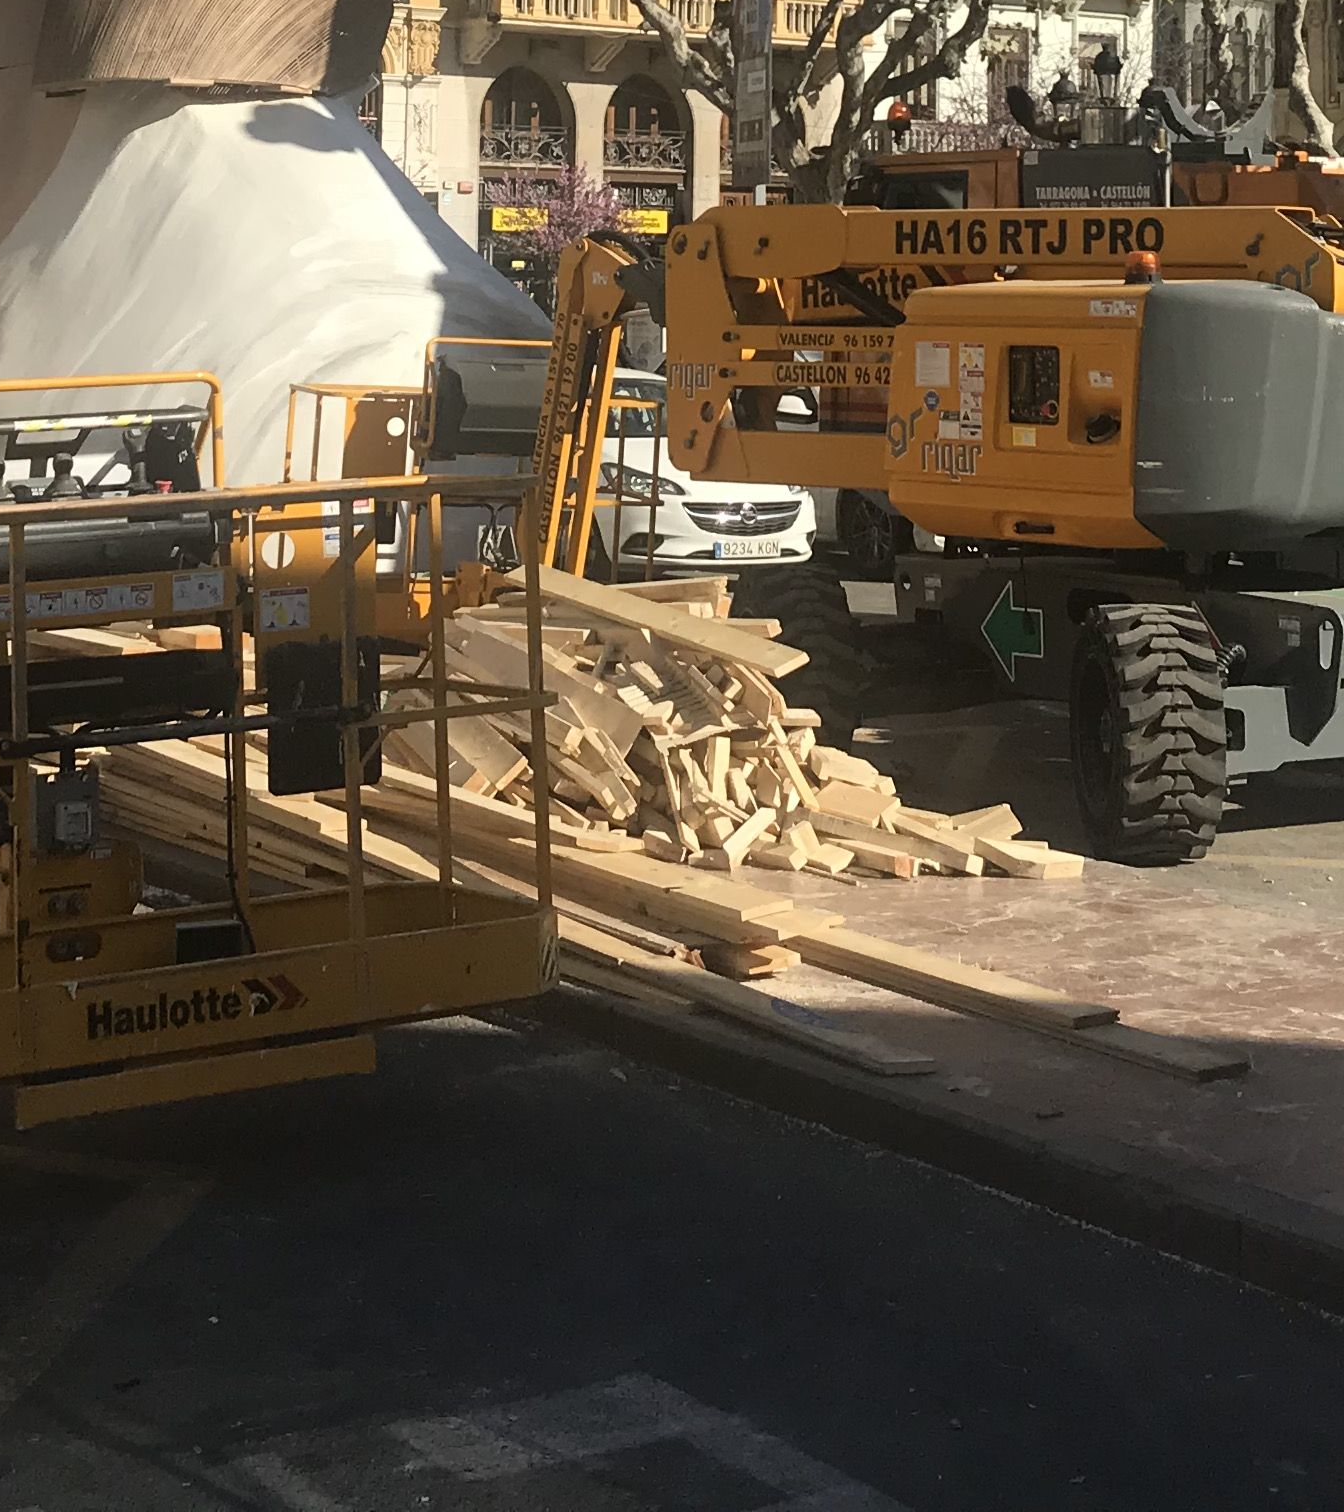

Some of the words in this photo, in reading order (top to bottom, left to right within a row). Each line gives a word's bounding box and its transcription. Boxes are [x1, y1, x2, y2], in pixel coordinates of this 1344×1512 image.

[1036, 186, 1090, 200] TARRAGONA
[895, 219, 987, 255] HA16
[999, 219, 1067, 255] RTJ
[1082, 217, 1165, 255] PRO
[568, 341, 577, 362] 00
[780, 333, 835, 346] VALENCIA
[843, 335, 858, 348] 96
[862, 335, 884, 348] 159
[563, 366, 574, 391] 19
[669, 355, 718, 401] rigar
[776, 365, 847, 384] CASTELLON
[855, 366, 871, 385] 96
[558, 394, 570, 424] 421
[538, 452, 560, 544] CASTELLON
[723, 542, 754, 555] 9234
[757, 541, 779, 555] KGN
[87, 988, 243, 1040] Haulotte
